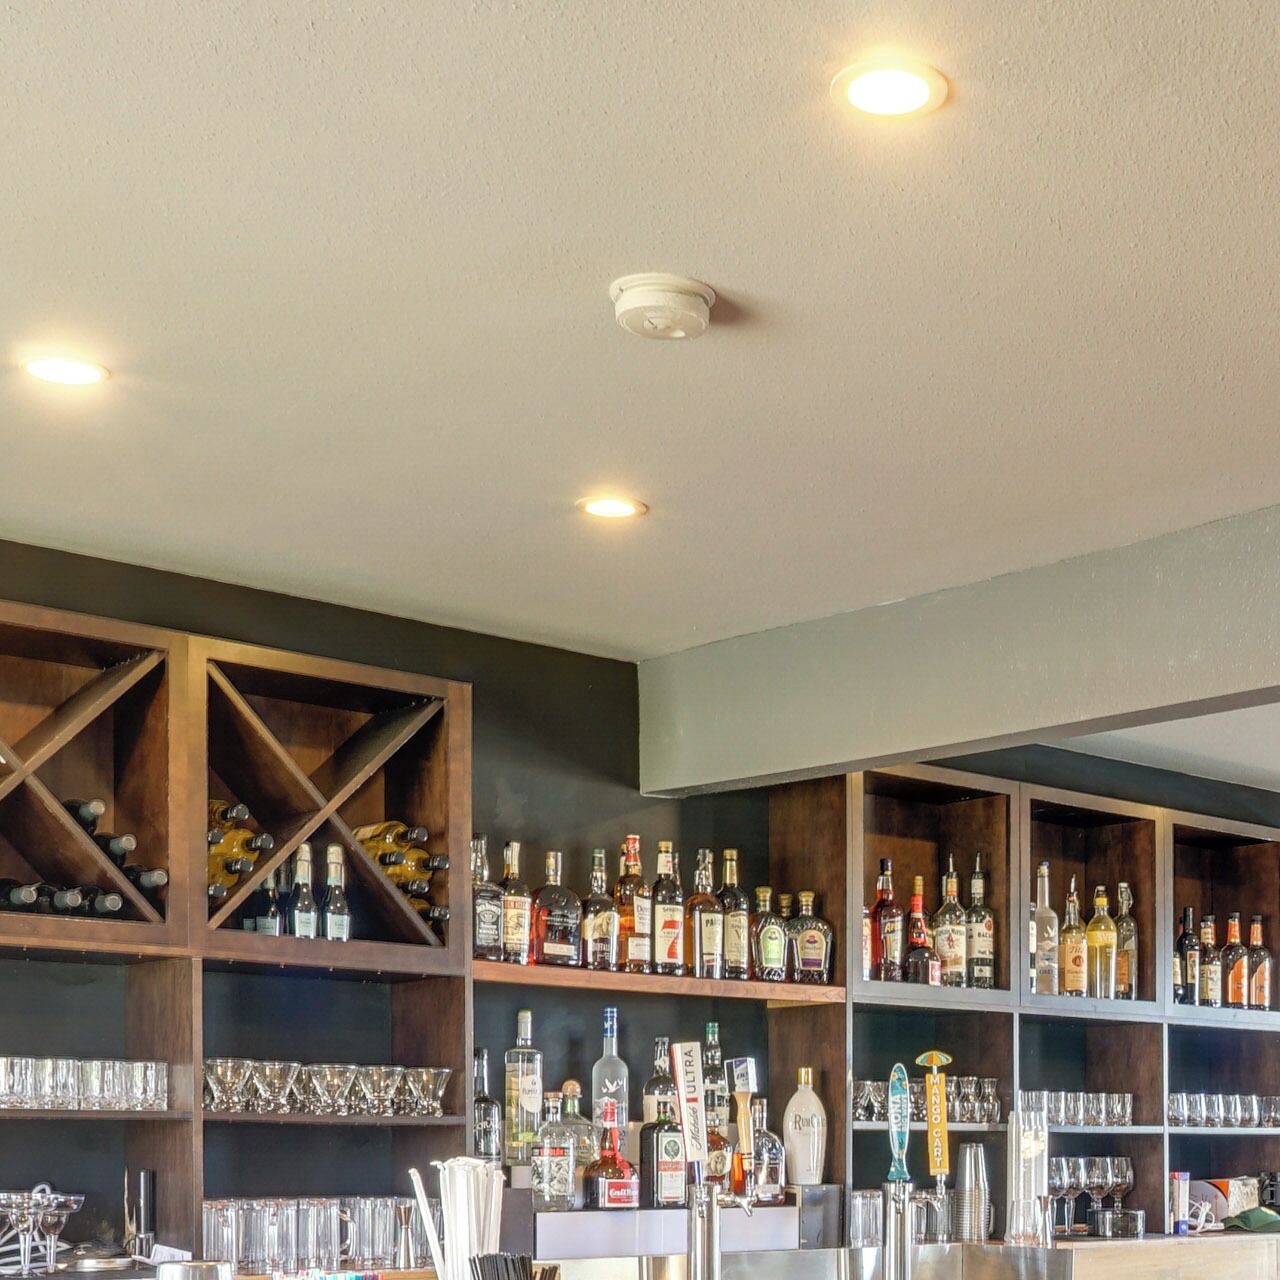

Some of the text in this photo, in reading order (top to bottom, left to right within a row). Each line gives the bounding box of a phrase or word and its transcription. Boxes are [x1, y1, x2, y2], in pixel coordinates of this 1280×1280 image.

[659, 919, 682, 959] 7
[685, 1048, 696, 1094] ULTRA
[890, 1095, 901, 1131] KONA
[930, 1075, 942, 1166] MANGO CART
